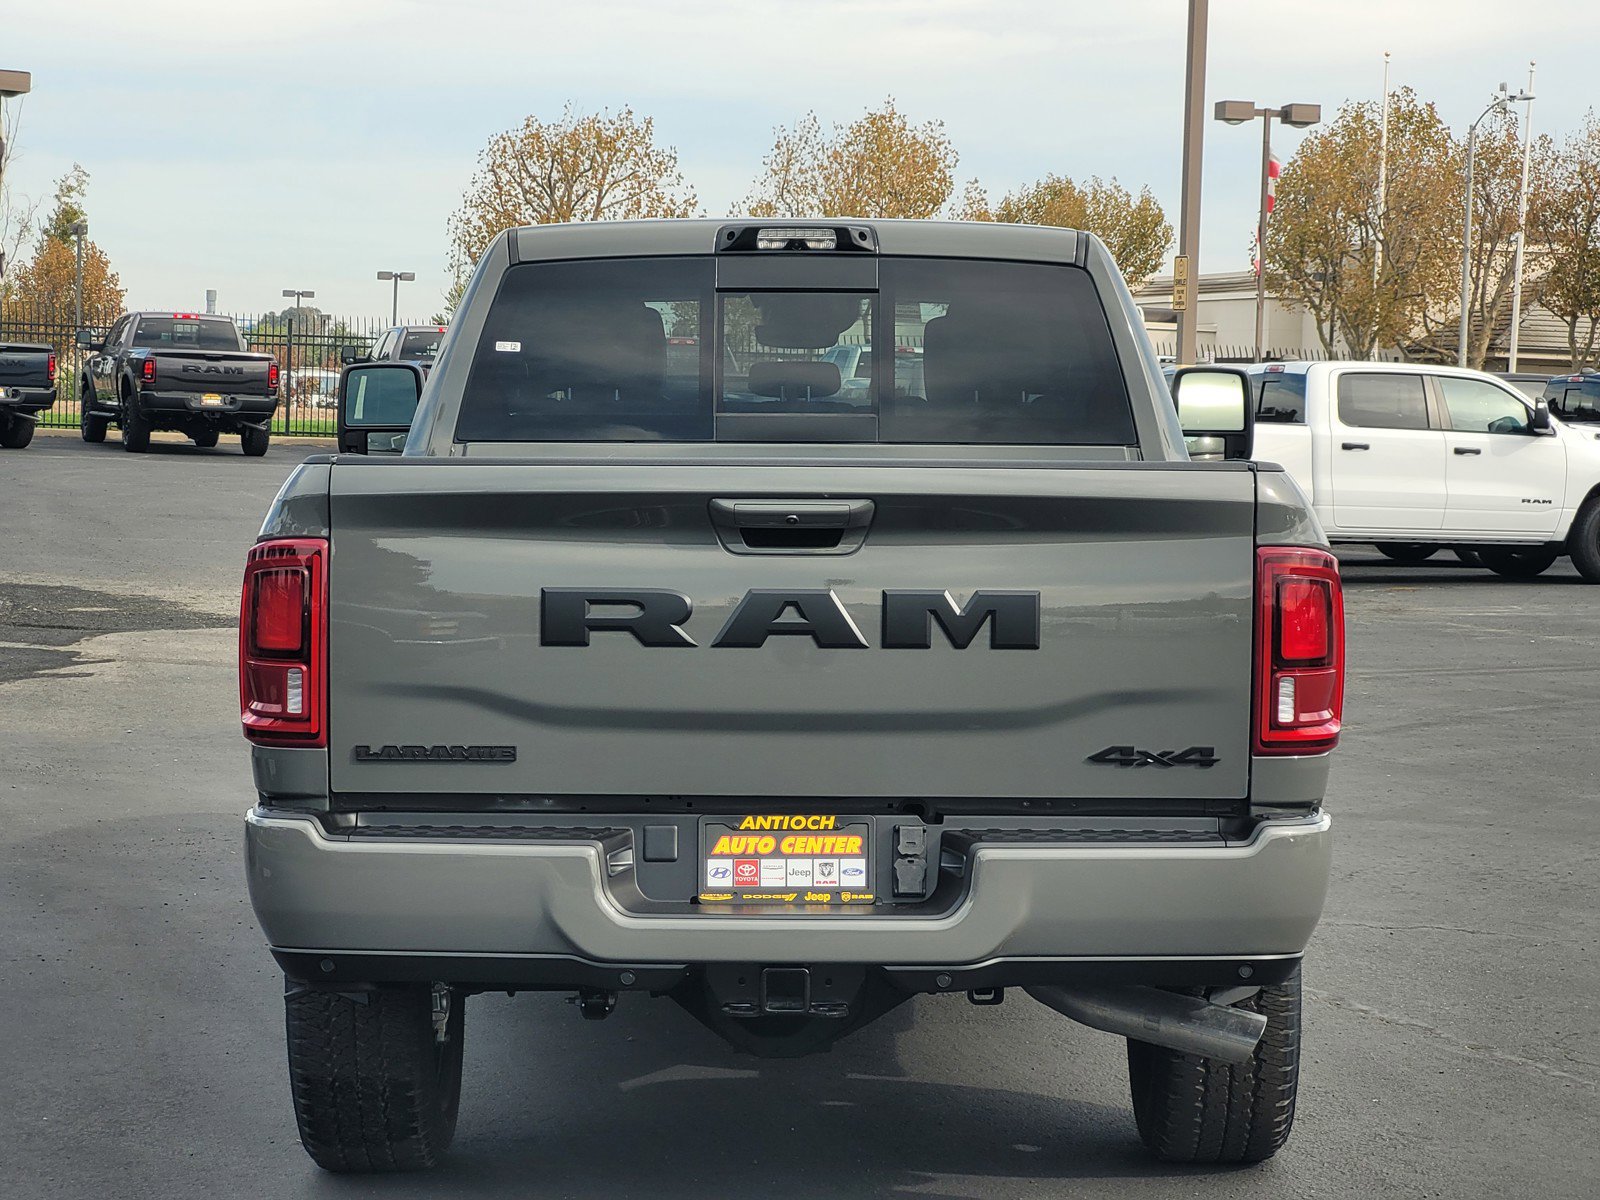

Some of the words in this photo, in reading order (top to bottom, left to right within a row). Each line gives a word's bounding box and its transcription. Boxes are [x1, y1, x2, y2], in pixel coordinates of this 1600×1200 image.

[181, 364, 244, 375] RAM
[540, 587, 1041, 650] RAM
[354, 745, 517, 762] LARAMIE
[738, 815, 836, 830] ANTIOCH
[711, 835, 777, 855] AUTO
[780, 835, 863, 855] CENTER
[788, 868, 811, 877] Jeep
[804, 891, 831, 902] Jeep
